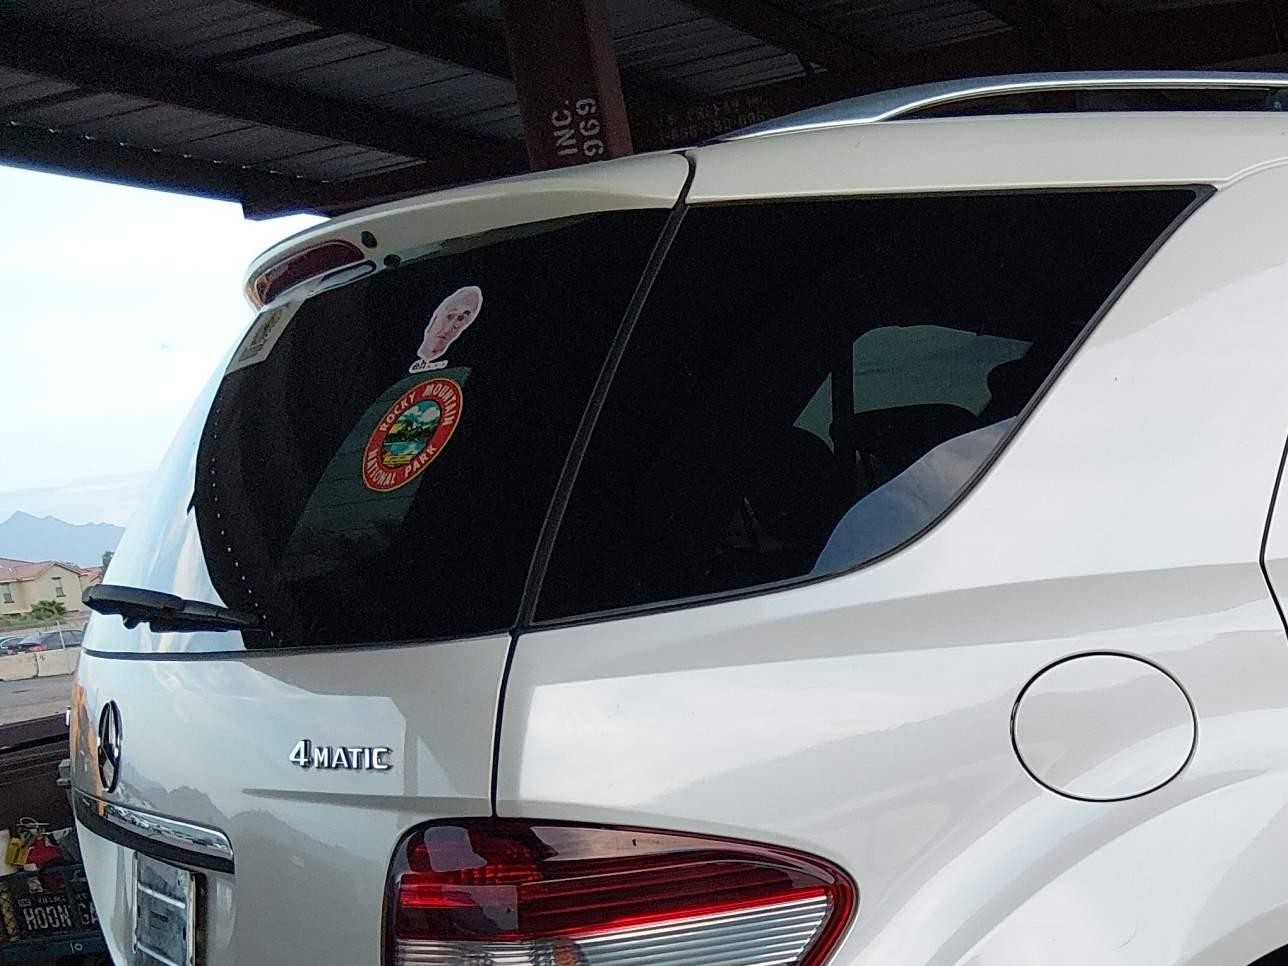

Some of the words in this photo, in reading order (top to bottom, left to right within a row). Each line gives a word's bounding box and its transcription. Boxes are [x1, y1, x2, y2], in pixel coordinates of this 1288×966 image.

[552, 100, 578, 156] INC.
[380, 391, 417, 433] ROCKY
[422, 382, 456, 427] MOUNTAIN
[367, 447, 397, 486] NATIONAL
[404, 444, 438, 478] PARK
